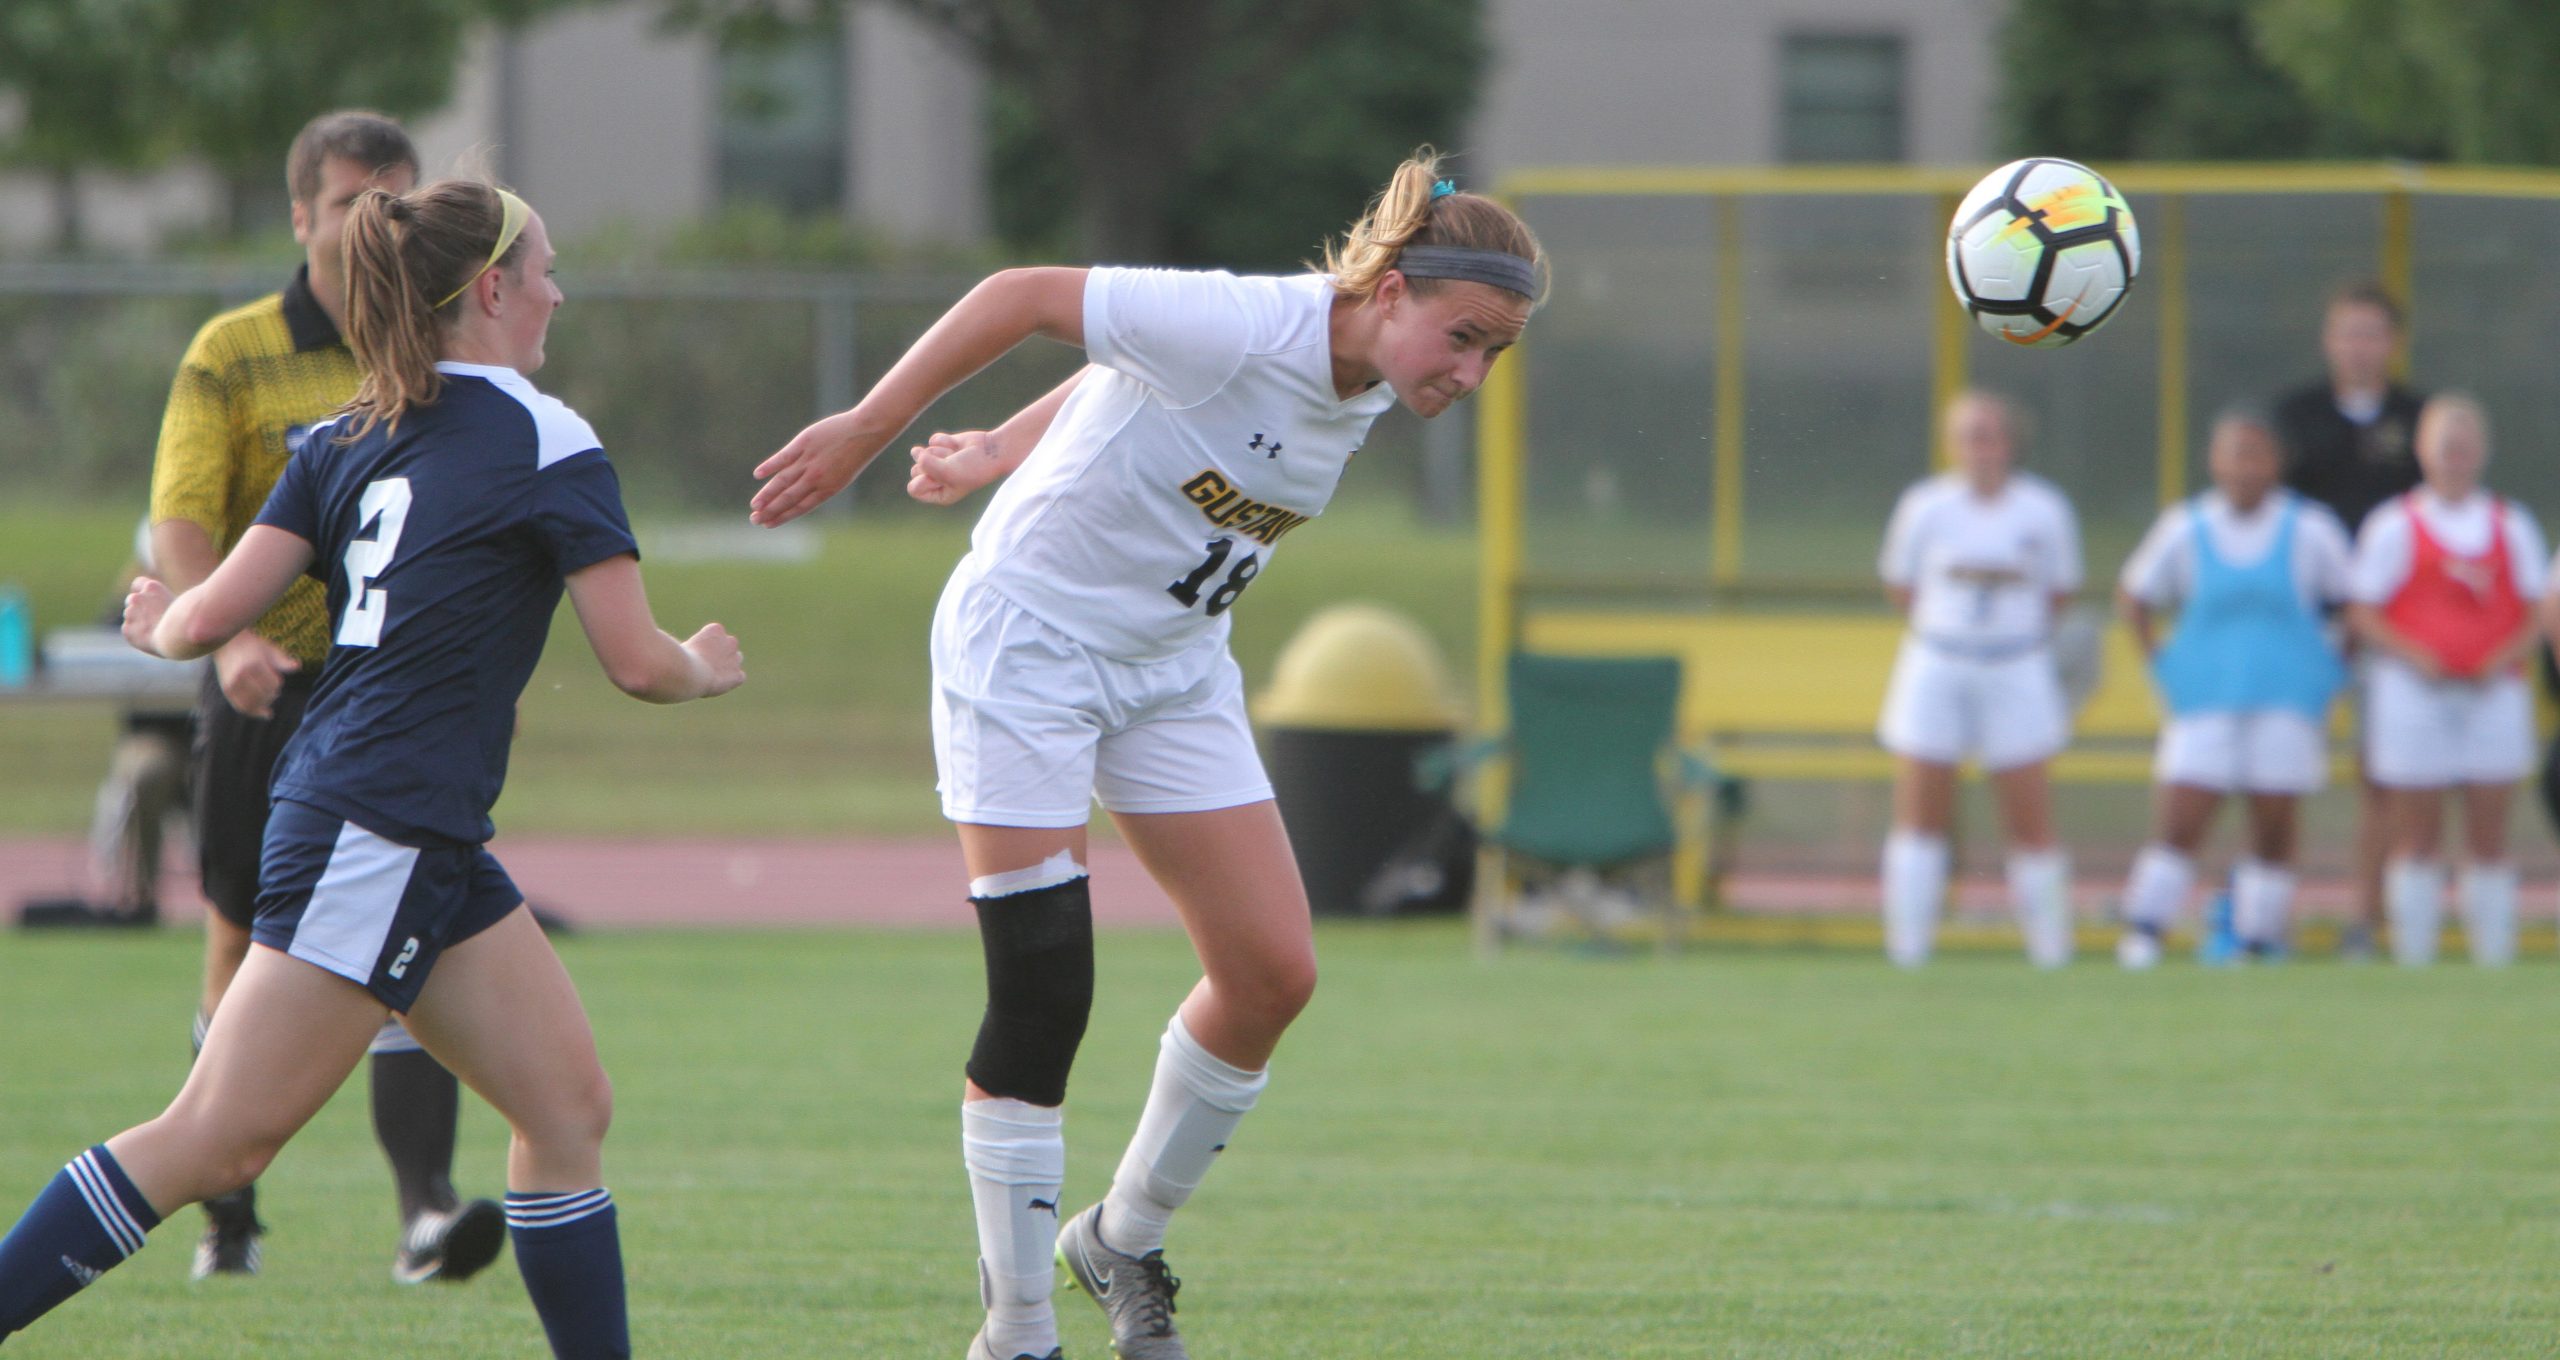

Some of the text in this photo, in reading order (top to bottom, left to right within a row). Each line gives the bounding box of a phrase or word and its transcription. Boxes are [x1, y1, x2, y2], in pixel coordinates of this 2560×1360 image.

[1180, 468, 1310, 546] GUSTAV
[336, 477, 413, 648] 2
[1166, 537, 1259, 617] 18
[388, 936, 419, 979] 2
